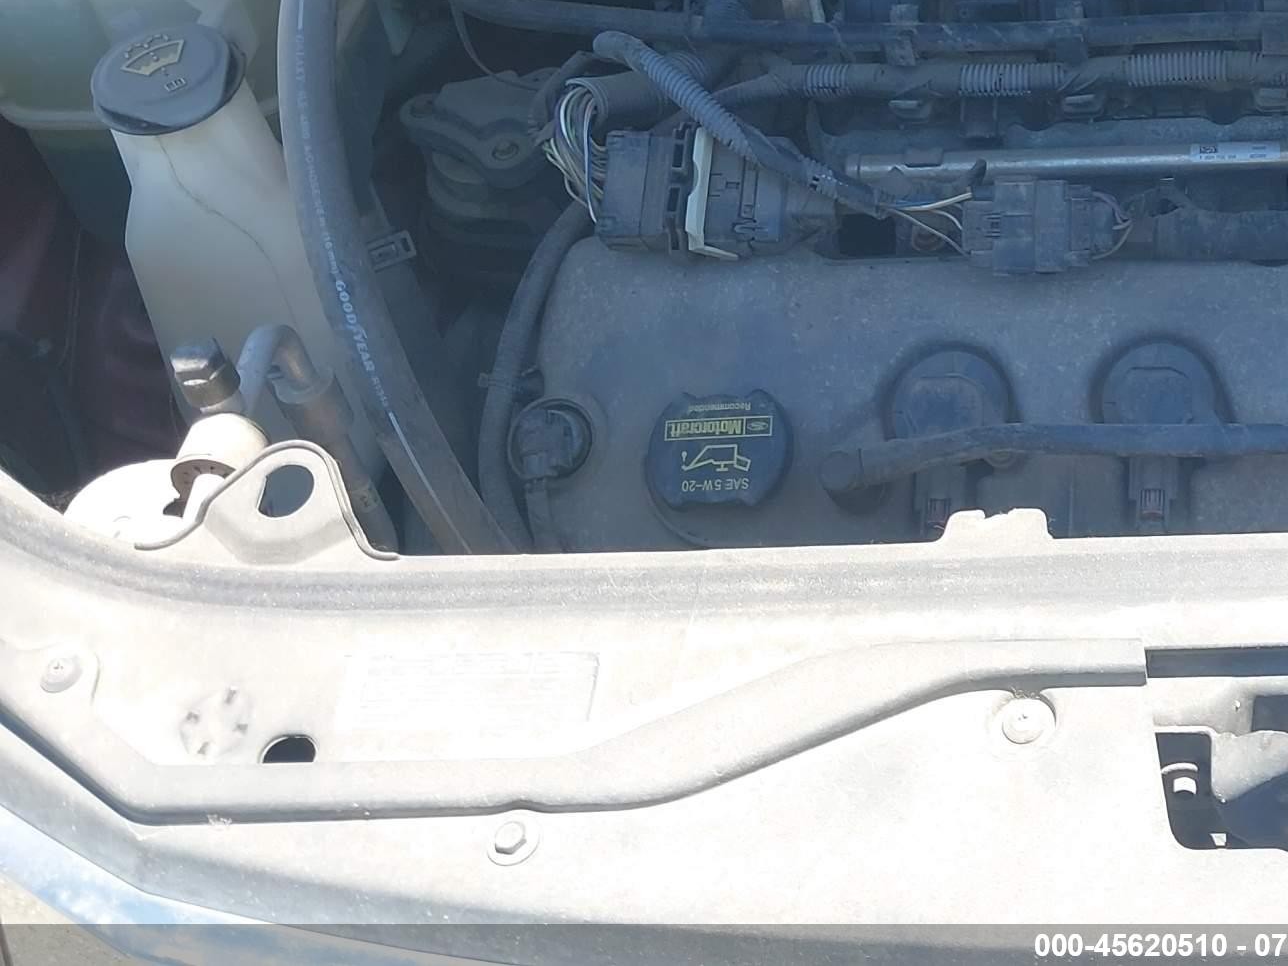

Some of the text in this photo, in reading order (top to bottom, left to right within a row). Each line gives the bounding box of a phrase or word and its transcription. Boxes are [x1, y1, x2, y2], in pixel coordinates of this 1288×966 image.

[335, 279, 375, 372] GOODYEAR
[687, 402, 751, 412] Recommended
[670, 420, 742, 437] Motorcraft
[725, 477, 750, 491] SAE
